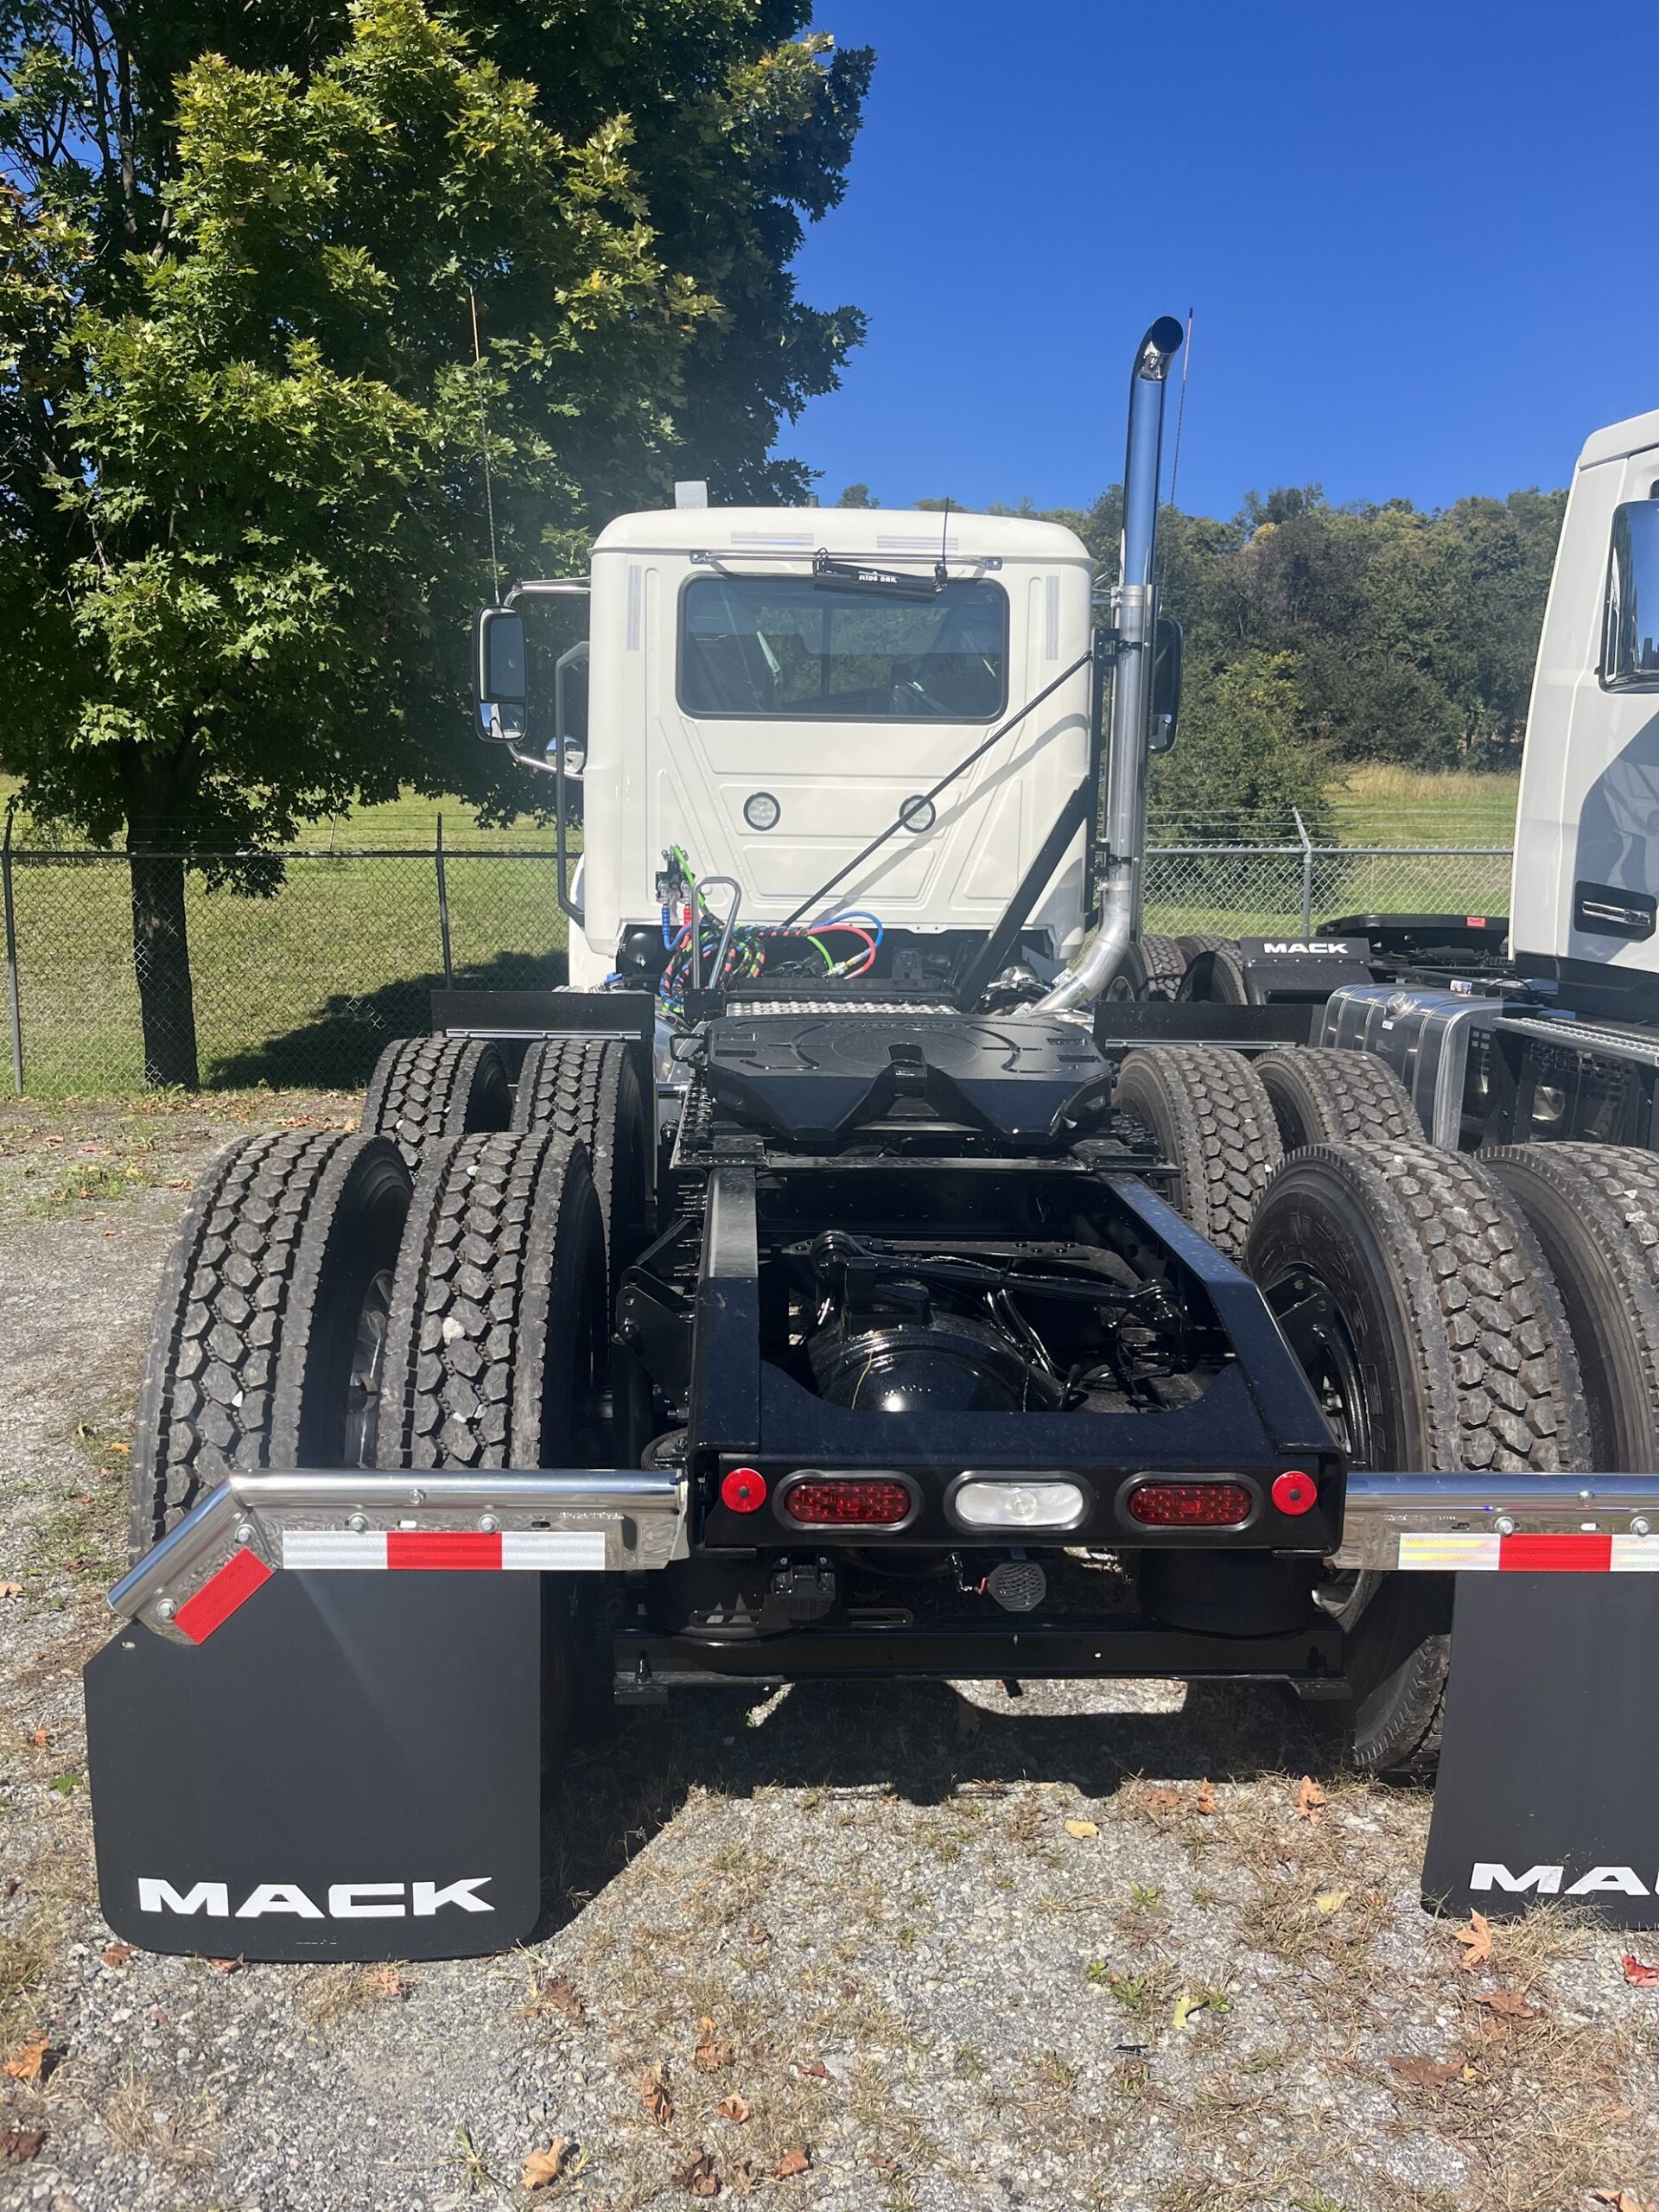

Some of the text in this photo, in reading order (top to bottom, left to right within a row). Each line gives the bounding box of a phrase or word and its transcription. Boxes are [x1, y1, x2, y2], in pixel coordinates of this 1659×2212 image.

[1263, 943, 1349, 954] MACK
[1470, 1862, 1659, 1896] MA
[137, 1877, 495, 1918] MACK
